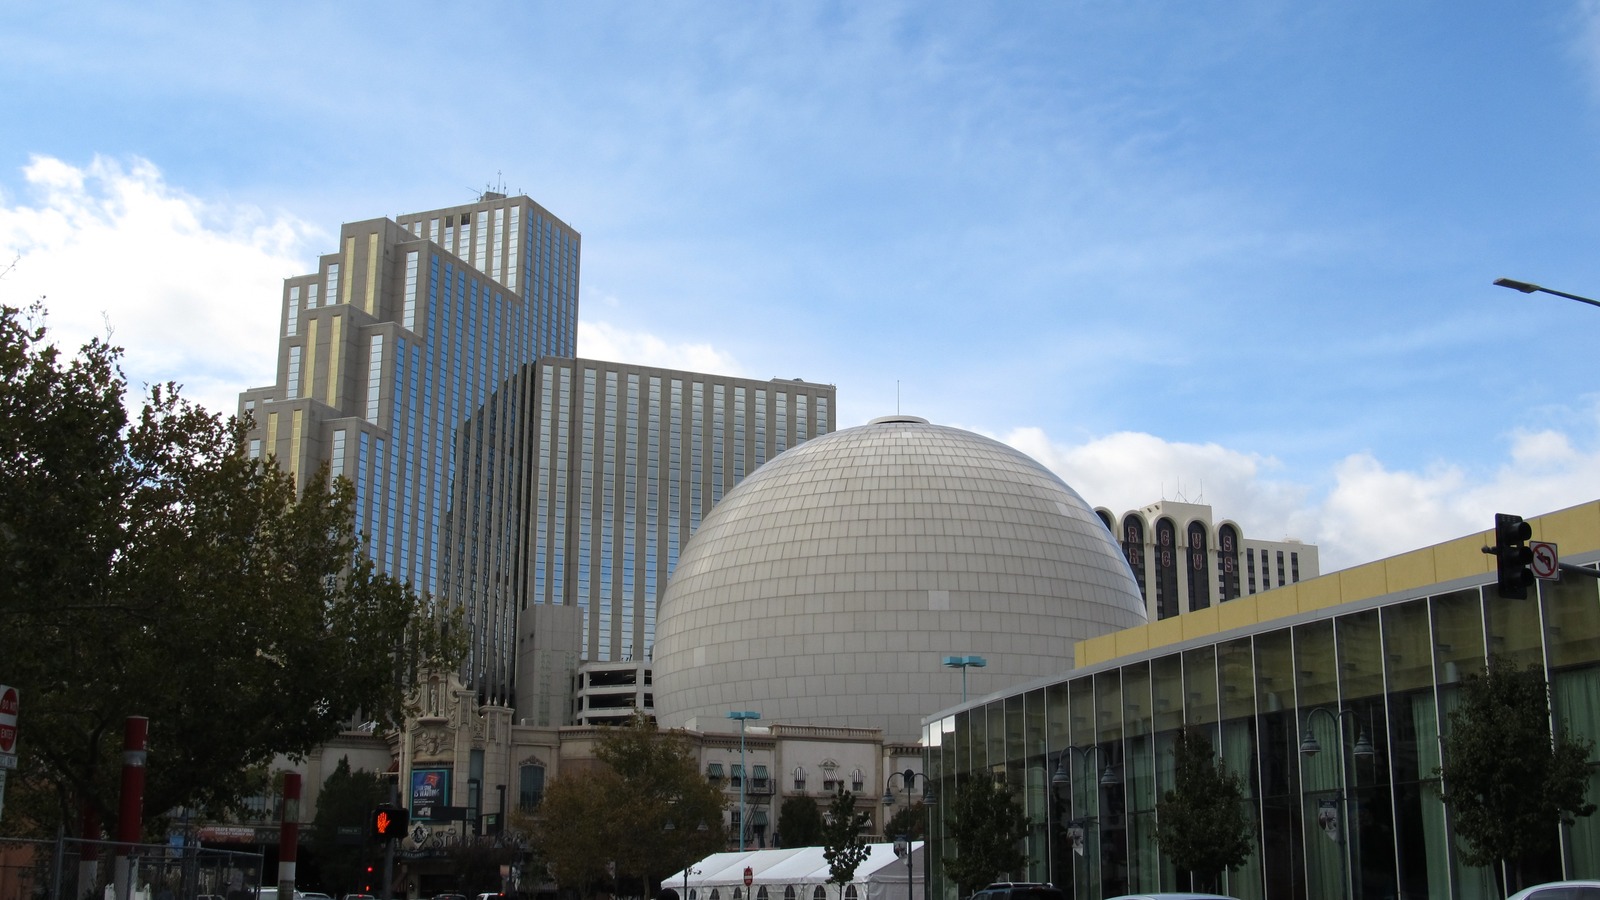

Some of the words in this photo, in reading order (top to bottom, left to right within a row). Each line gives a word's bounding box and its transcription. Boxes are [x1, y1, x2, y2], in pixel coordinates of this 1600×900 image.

[1128, 526, 1232, 552] RCUS
[1129, 547, 1233, 573] RCUS
[2, 700, 9, 710] DO
[1, 729, 13, 738] ENTER
